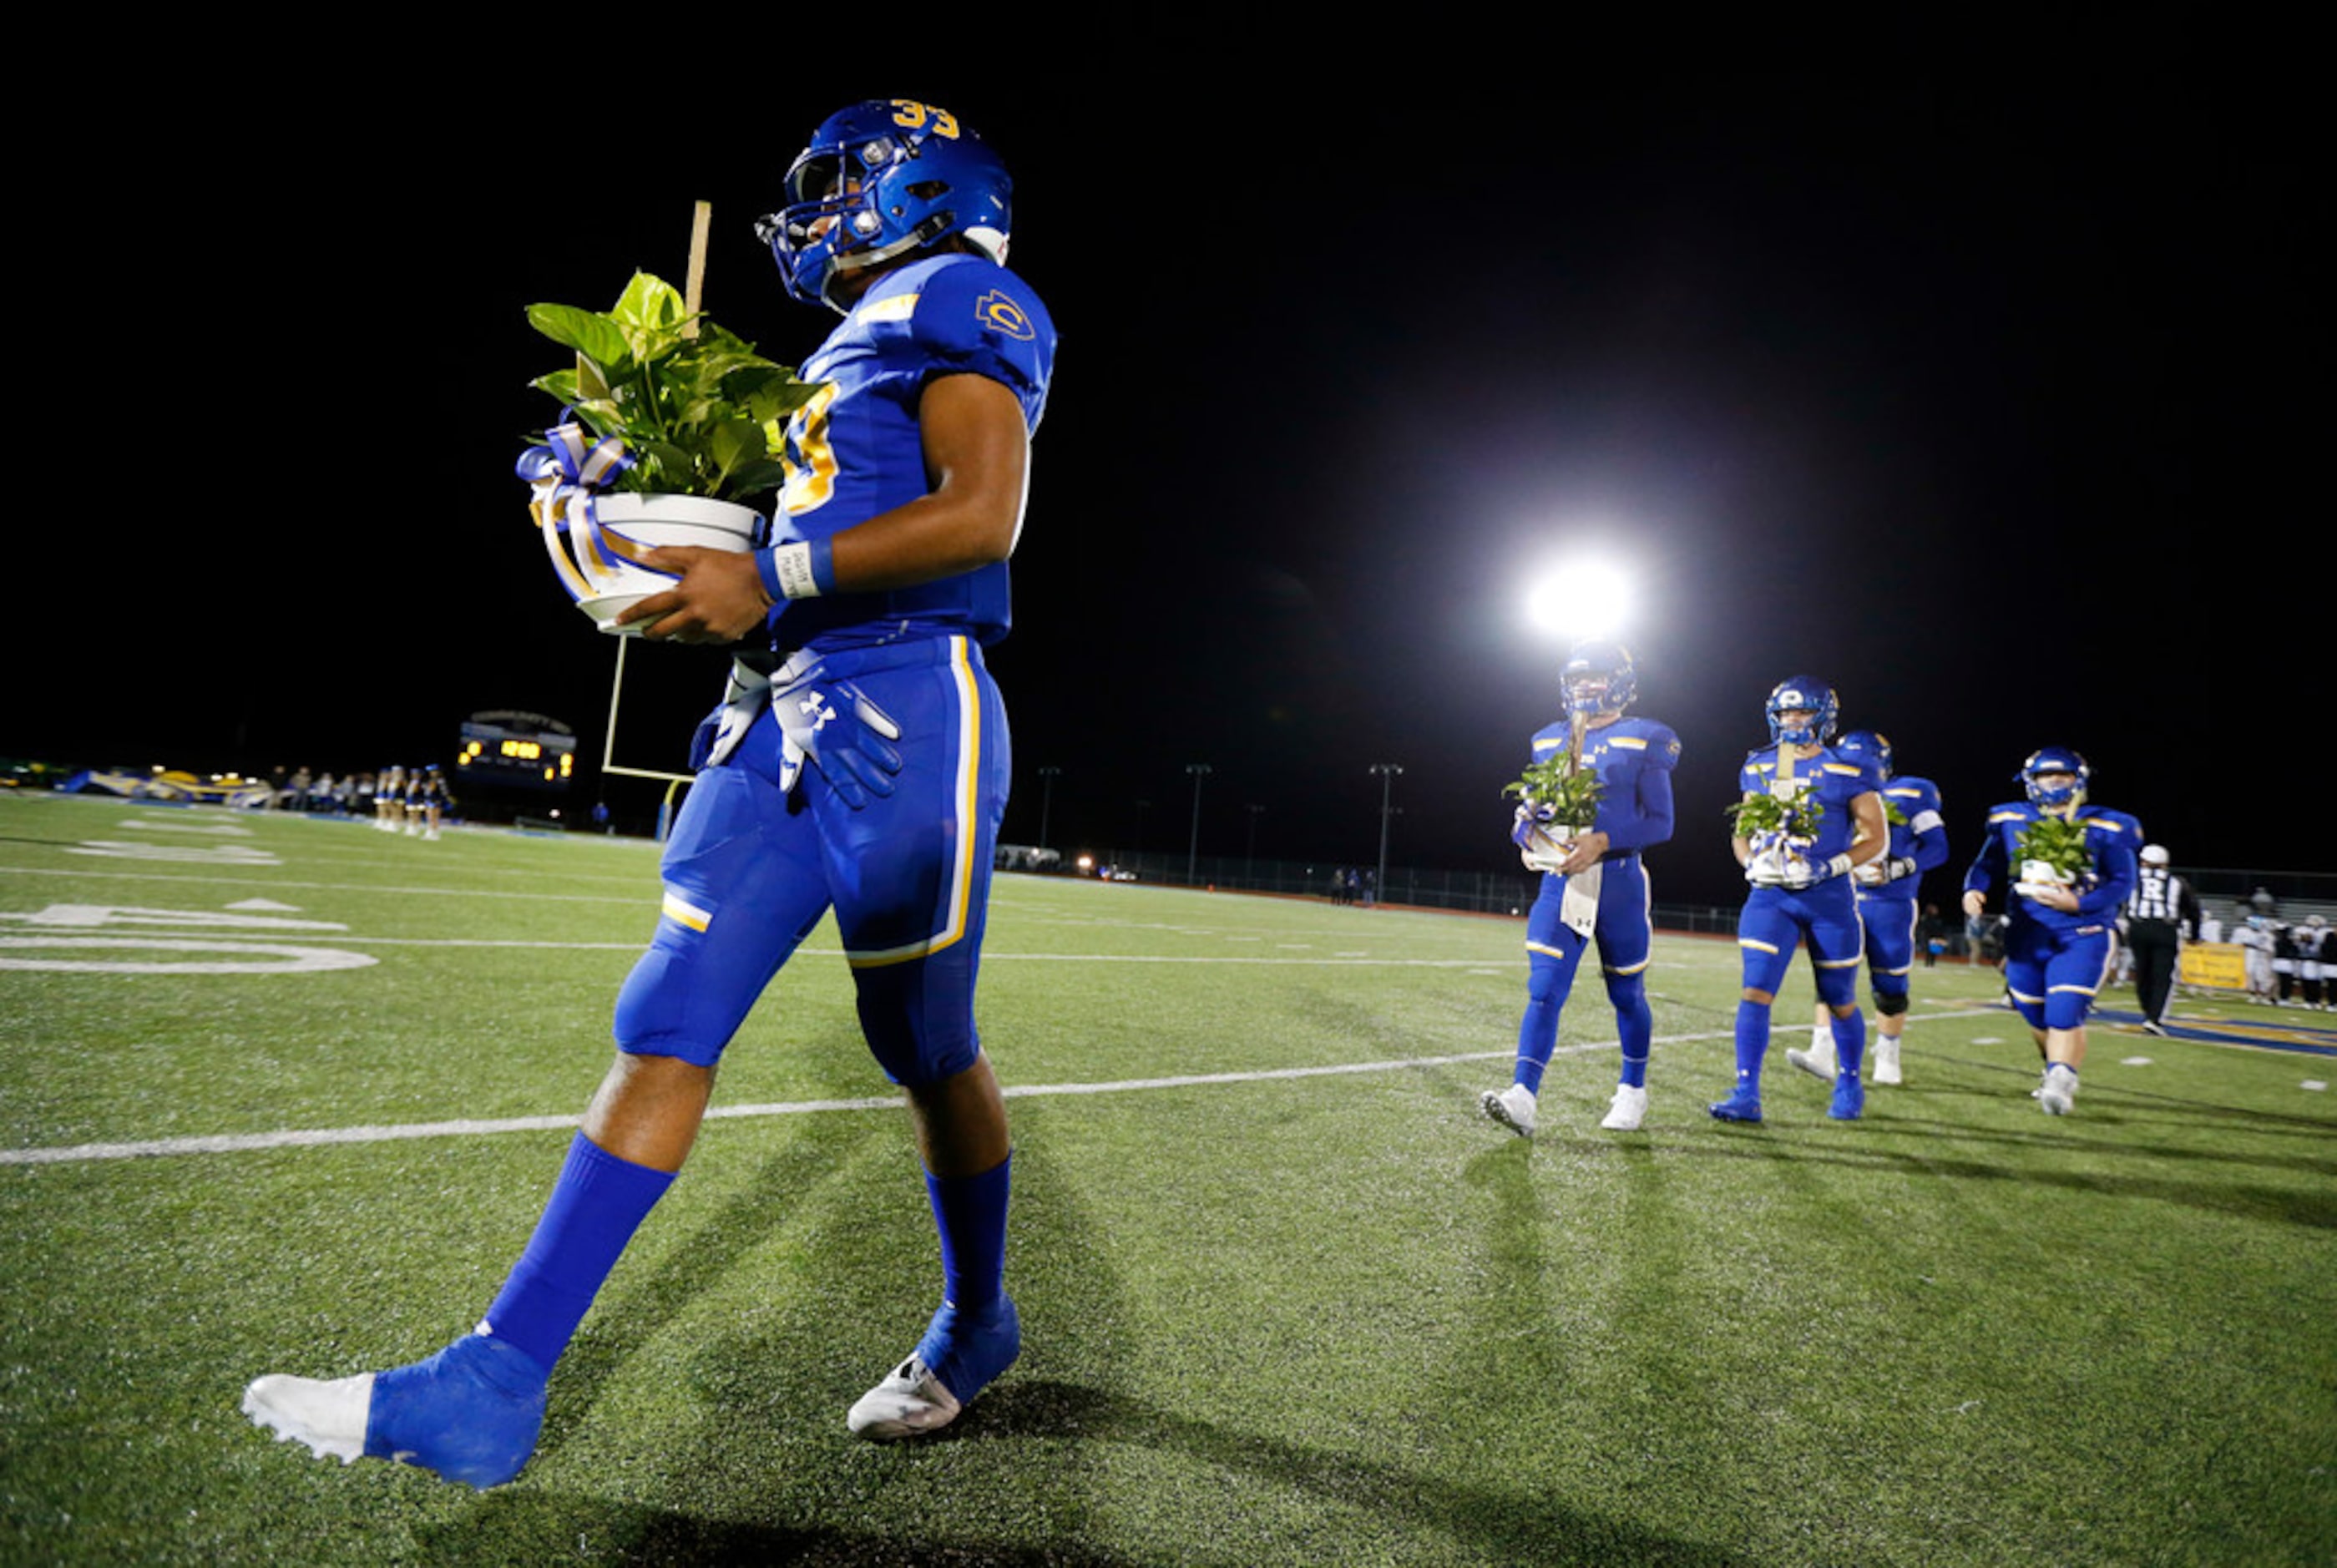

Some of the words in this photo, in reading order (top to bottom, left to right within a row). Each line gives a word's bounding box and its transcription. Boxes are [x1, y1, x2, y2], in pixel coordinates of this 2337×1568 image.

[890, 99, 960, 140] 33
[989, 303, 1023, 331] C
[2142, 878, 2166, 900] R
